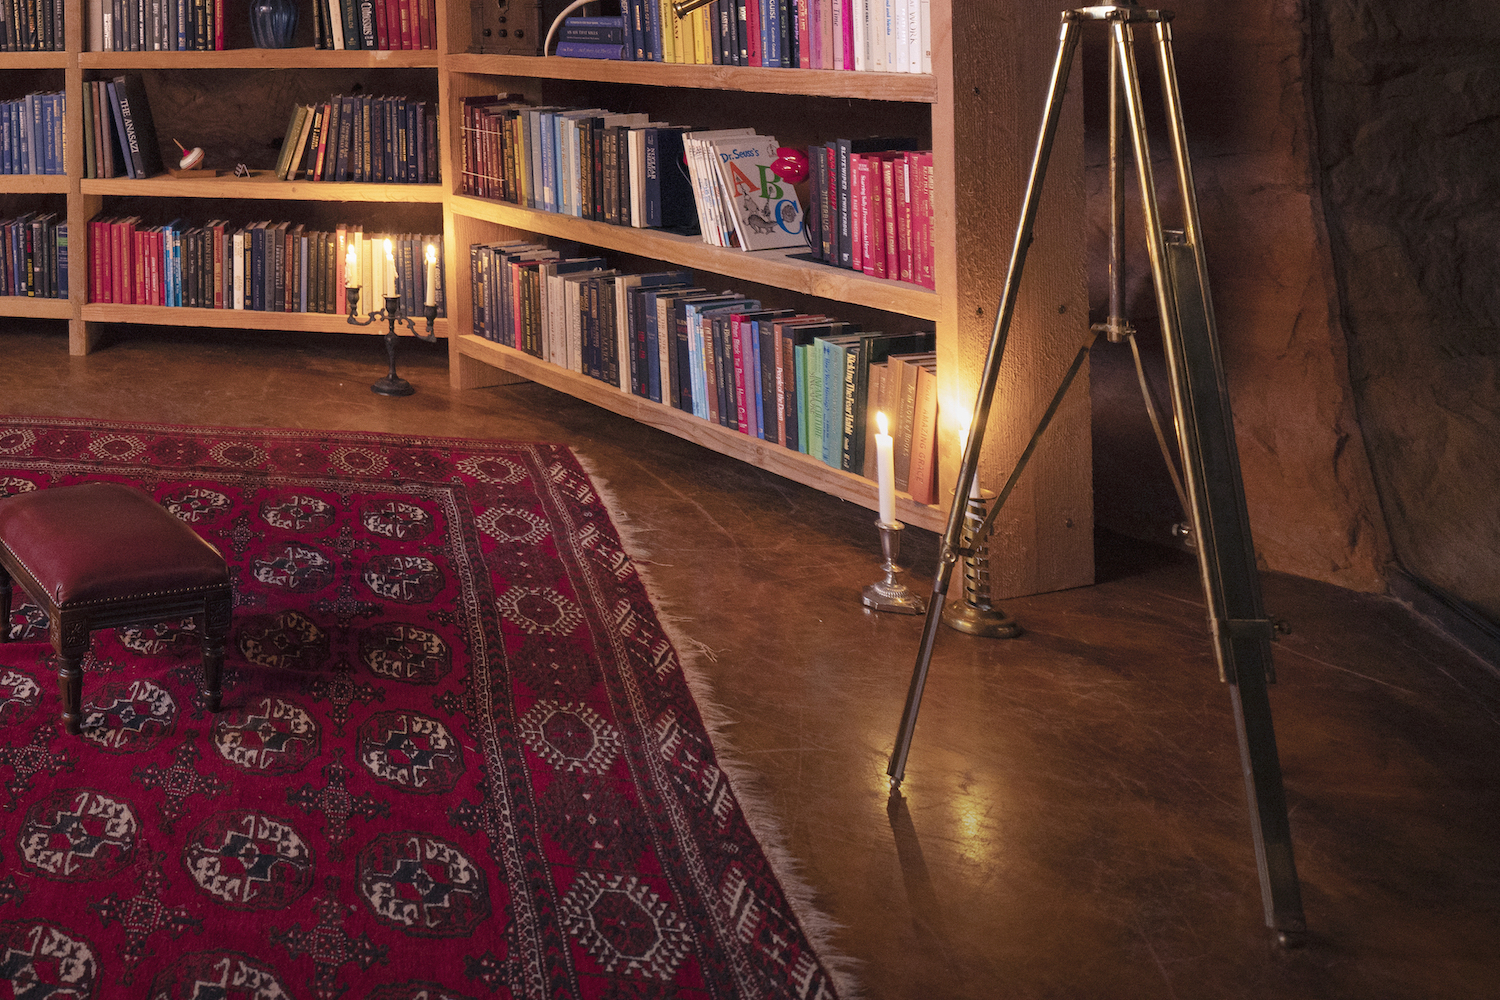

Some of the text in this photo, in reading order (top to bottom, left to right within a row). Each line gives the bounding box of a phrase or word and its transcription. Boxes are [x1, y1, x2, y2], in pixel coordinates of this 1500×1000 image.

[361, 3, 373, 35] Colossus
[120, 99, 139, 154] THE ANASAZI
[720, 148, 760, 163] Dr. Seuss's
[730, 162, 802, 234] A B C
[845, 353, 856, 436] Kicking The Fear Habit
[916, 409, 930, 484] AMAZING GRACE
